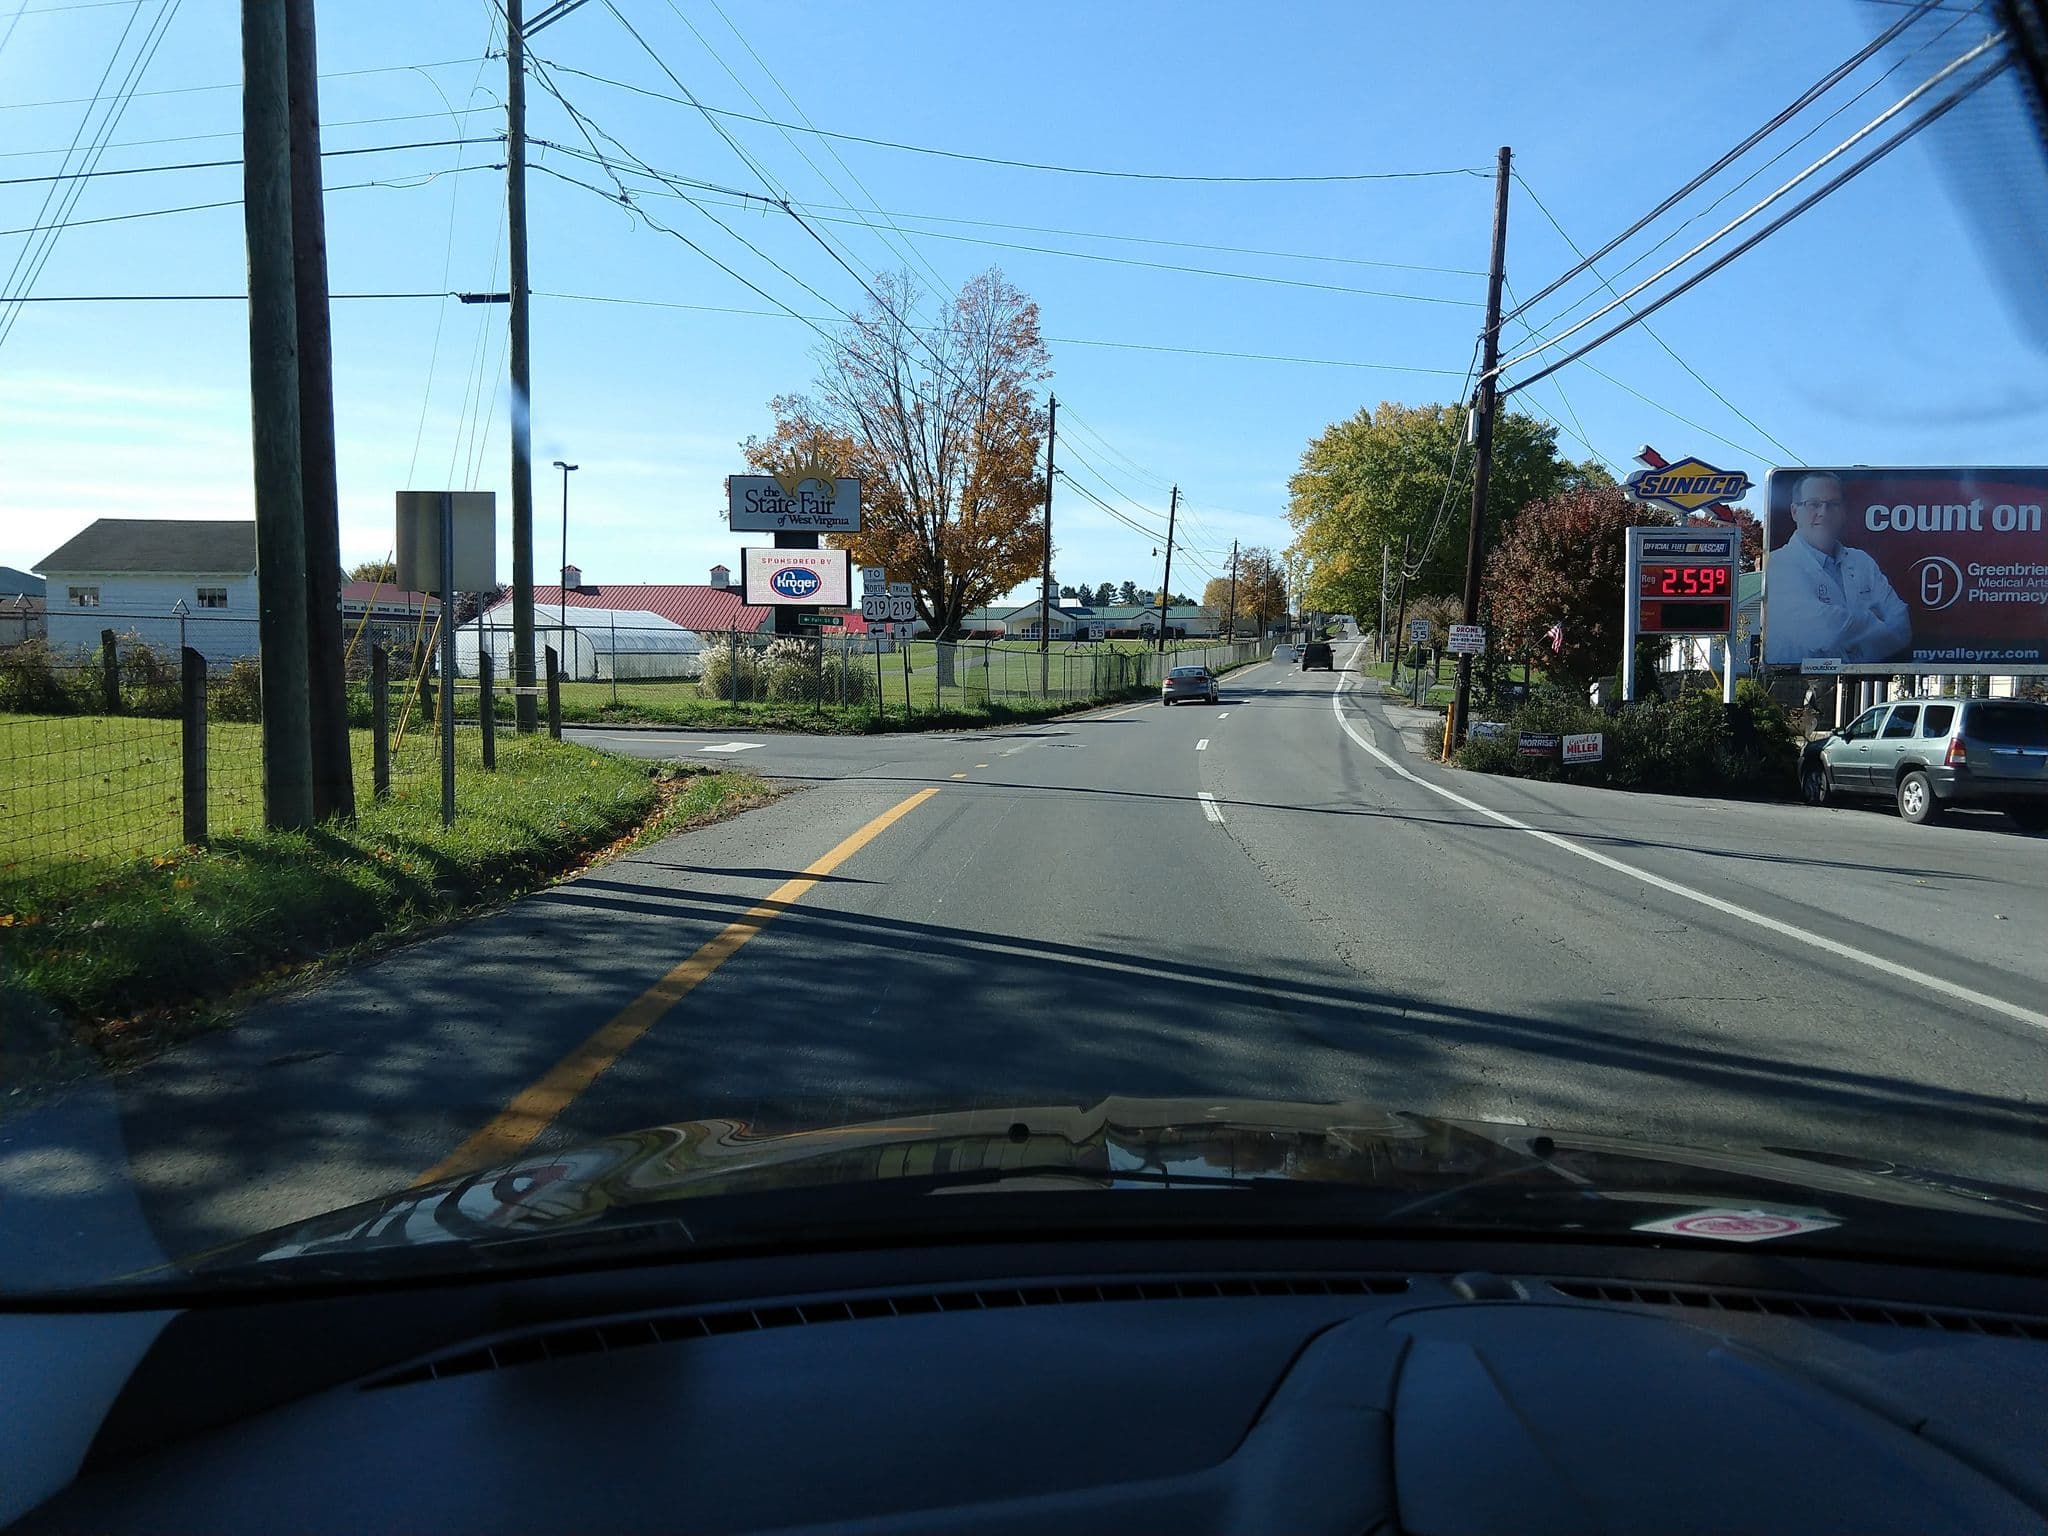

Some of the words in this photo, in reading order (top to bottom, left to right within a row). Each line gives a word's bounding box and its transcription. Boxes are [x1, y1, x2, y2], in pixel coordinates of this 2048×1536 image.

[764, 486, 780, 497] the
[1642, 477, 1744, 495] SUNOCO
[745, 489, 797, 513] State
[800, 491, 835, 515] Fair
[777, 514, 788, 527] of
[789, 515, 812, 525] West
[813, 515, 850, 528] Virginia
[1865, 499, 1984, 531] count
[1992, 504, 2042, 531] on
[761, 557, 816, 565] SPONSORED
[867, 569, 881, 577] TO
[1967, 562, 2048, 576] Greenbrier
[777, 571, 817, 594] Kroger
[1641, 574, 1656, 584] Reg
[1978, 577, 2024, 587] Medical
[864, 583, 885, 593] NORTH
[892, 585, 910, 594] TRUCK
[1968, 589, 2048, 605] Pharmacy
[866, 600, 886, 616] 219
[893, 601, 912, 616] 219
[1091, 629, 1103, 637] 35
[1412, 630, 1427, 639] 35
[1913, 648, 2039, 661] myvalleyrx.com
[1567, 743, 1599, 754] MILLER
